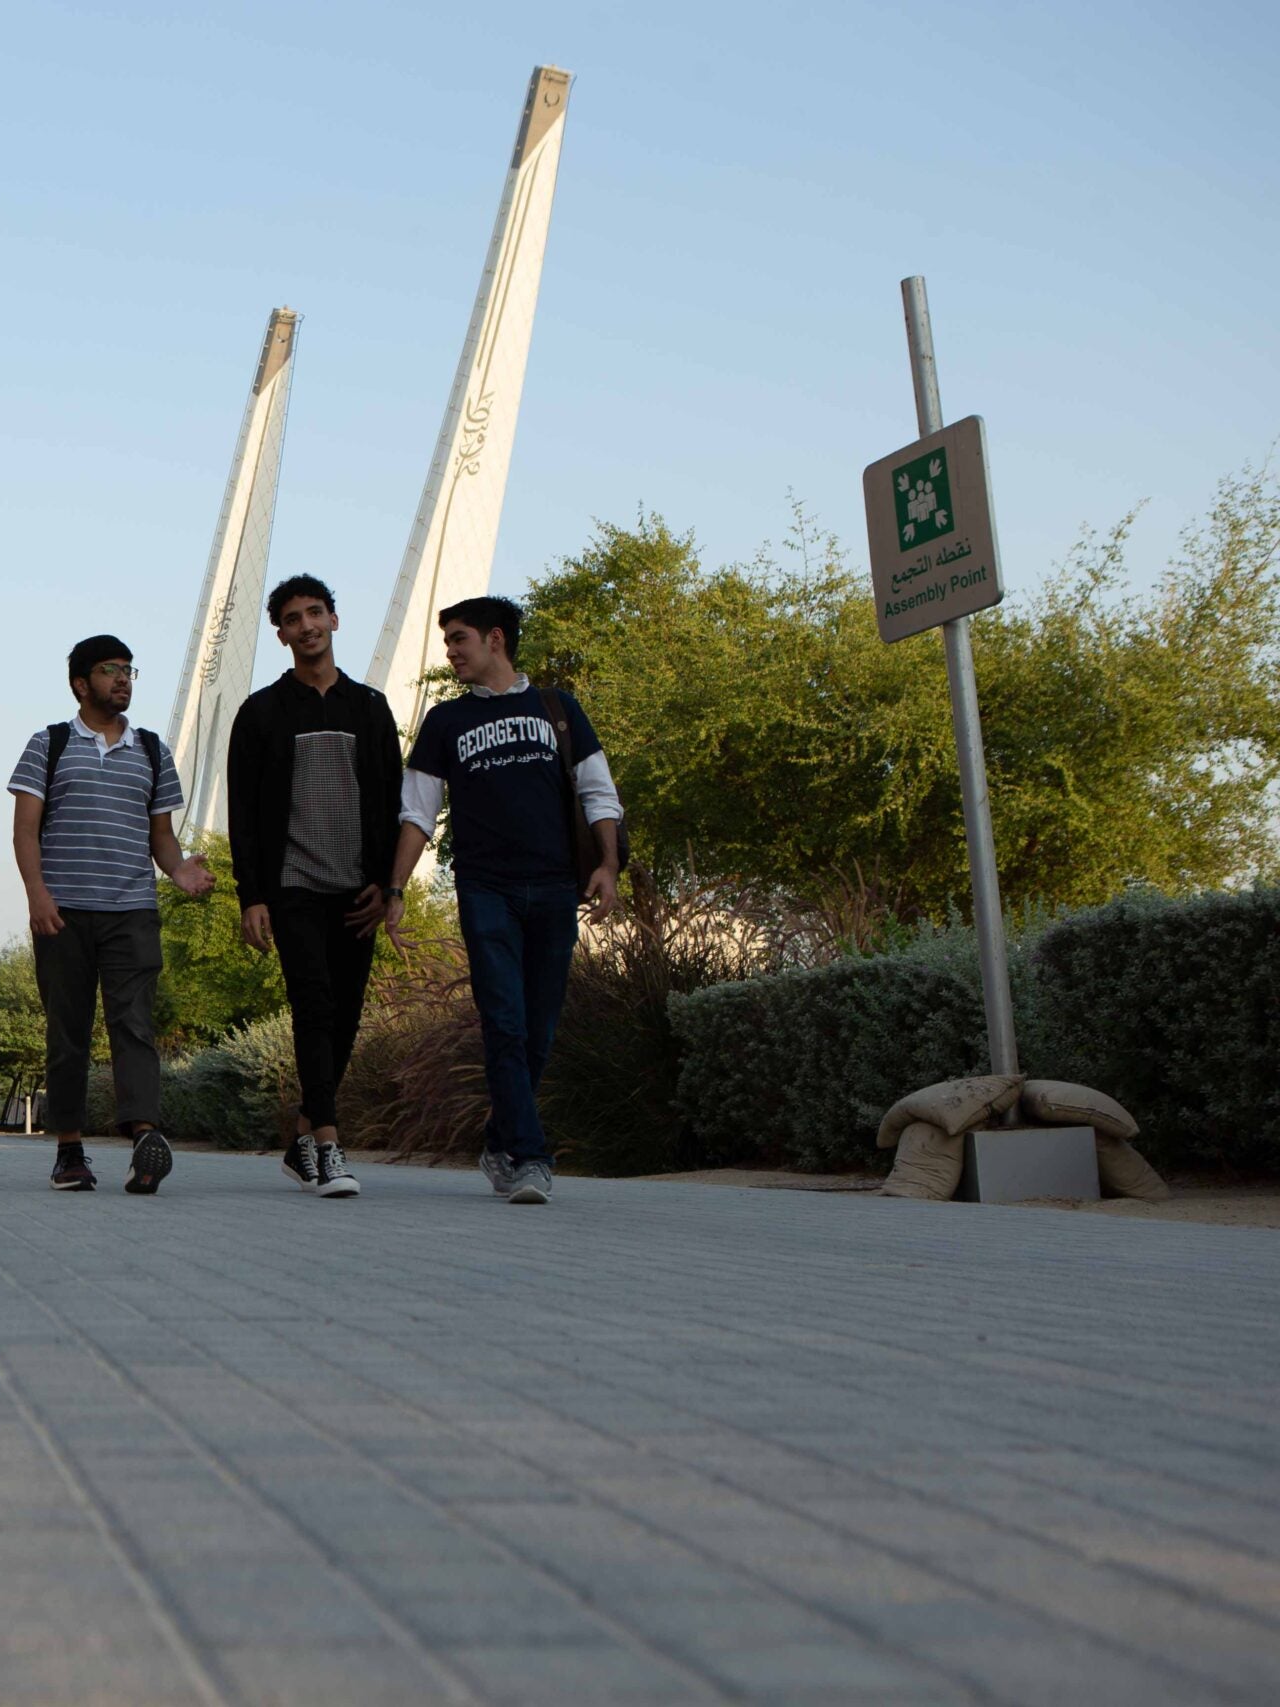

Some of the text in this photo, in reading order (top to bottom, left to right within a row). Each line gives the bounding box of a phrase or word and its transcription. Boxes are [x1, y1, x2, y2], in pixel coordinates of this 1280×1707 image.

[884, 565, 987, 619] Assembly Point
[891, 554, 933, 594] التجمع
[483, 758, 491, 771] في
